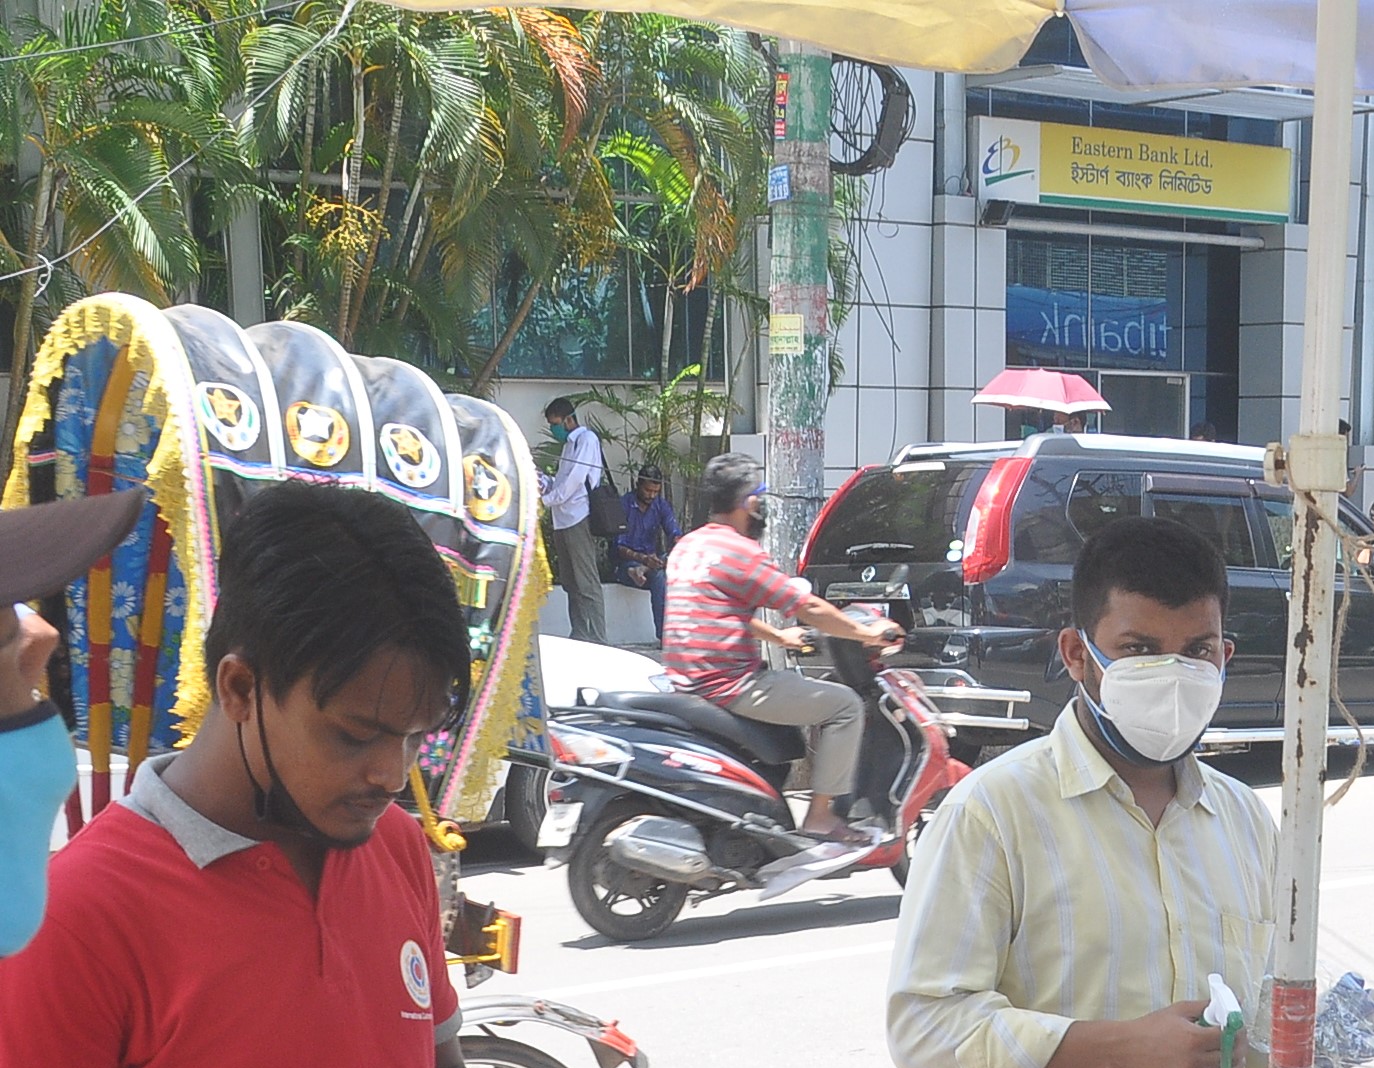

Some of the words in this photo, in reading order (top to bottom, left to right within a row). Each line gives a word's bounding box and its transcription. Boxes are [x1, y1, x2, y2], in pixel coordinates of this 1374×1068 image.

[1072, 136, 1133, 160] Eastern
[1139, 143, 1178, 164] Bank
[1184, 148, 1213, 168] Ltd.
[1116, 169, 1153, 194] ব্যাংক
[1158, 168, 1213, 195] লিমিটেড
